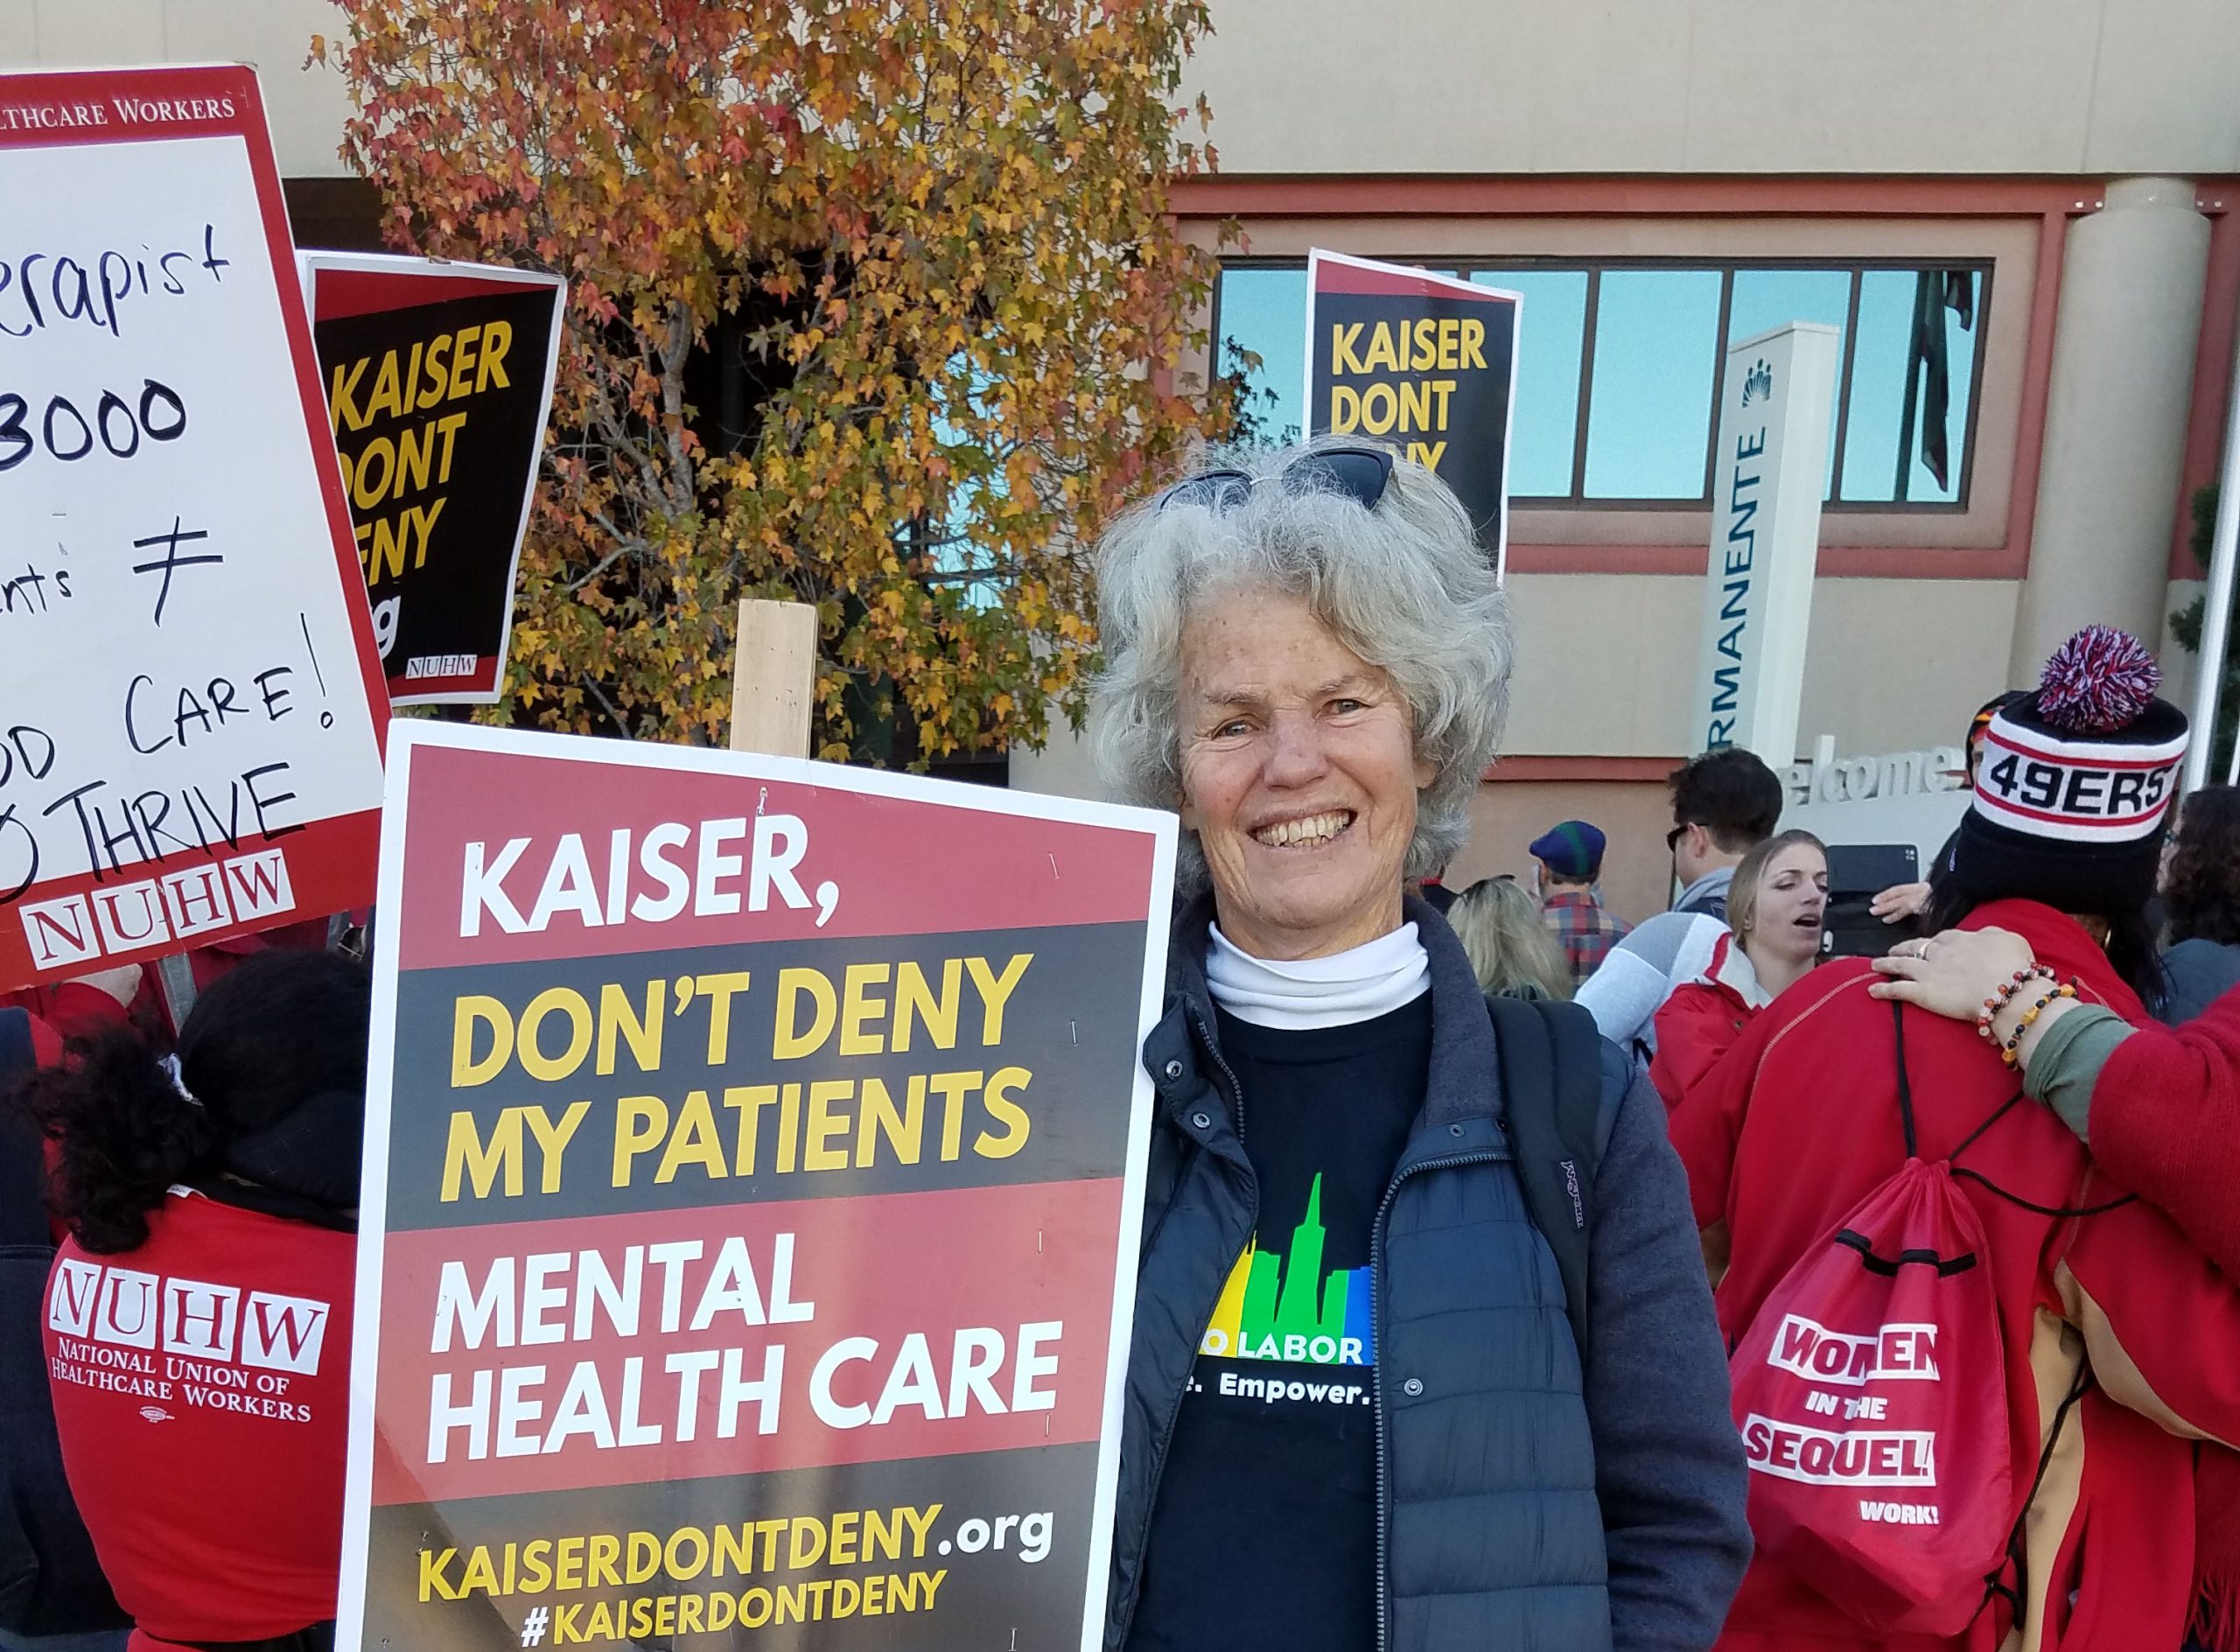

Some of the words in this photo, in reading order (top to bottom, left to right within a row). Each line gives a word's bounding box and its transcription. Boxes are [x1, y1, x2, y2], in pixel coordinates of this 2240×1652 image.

[330, 319, 513, 438] KAISER
[1332, 318, 1488, 376] KAISER
[1330, 380, 1457, 437] DONT
[0, 563, 72, 615] nts
[125, 612, 334, 754] CARE!
[406, 655, 477, 678] NUHW
[1782, 734, 1966, 808] elcome
[1990, 754, 2177, 816] 49ERS
[42, 761, 307, 884] THRIVE
[24, 850, 289, 963] NUHW
[458, 813, 840, 939] KAISER,
[450, 971, 750, 1089] DON'T
[772, 953, 1035, 1061] DENY
[440, 1101, 592, 1203] MY
[612, 1067, 1034, 1188] PATIENTS
[51, 1263, 328, 1368] NUHW
[430, 1232, 816, 1354] MENTAL
[58, 1336, 157, 1375] NATIONAL
[166, 1358, 248, 1390] UNION
[256, 1375, 290, 1396] OF
[1236, 1331, 1364, 1365] LABOR
[52, 1356, 173, 1401] HEALTHCARE
[182, 1384, 312, 1423] WORKERS
[426, 1342, 785, 1465] HEALTH
[808, 1320, 1063, 1431] CARE
[1219, 1372, 1370, 1405] Empower.
[1805, 1390, 1839, 1416] IN
[1859, 1500, 1939, 1525] WORK!
[520, 1569, 948, 1648] #KAISERDONTDENY
